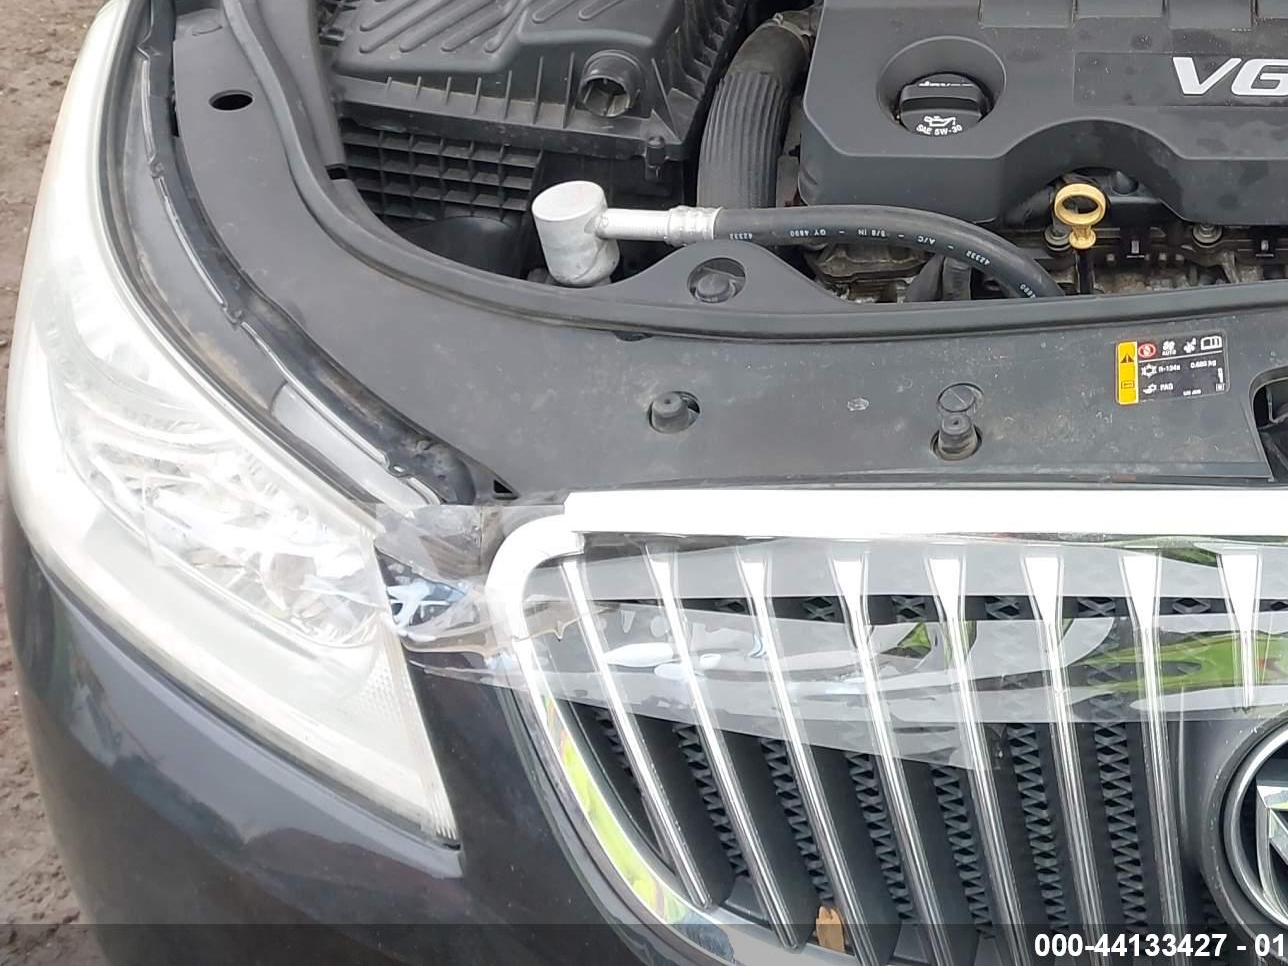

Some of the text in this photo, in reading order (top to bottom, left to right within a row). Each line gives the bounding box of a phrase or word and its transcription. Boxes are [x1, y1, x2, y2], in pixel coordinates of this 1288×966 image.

[916, 124, 963, 136] SAE 5W-30
[917, 235, 936, 246] A/C
